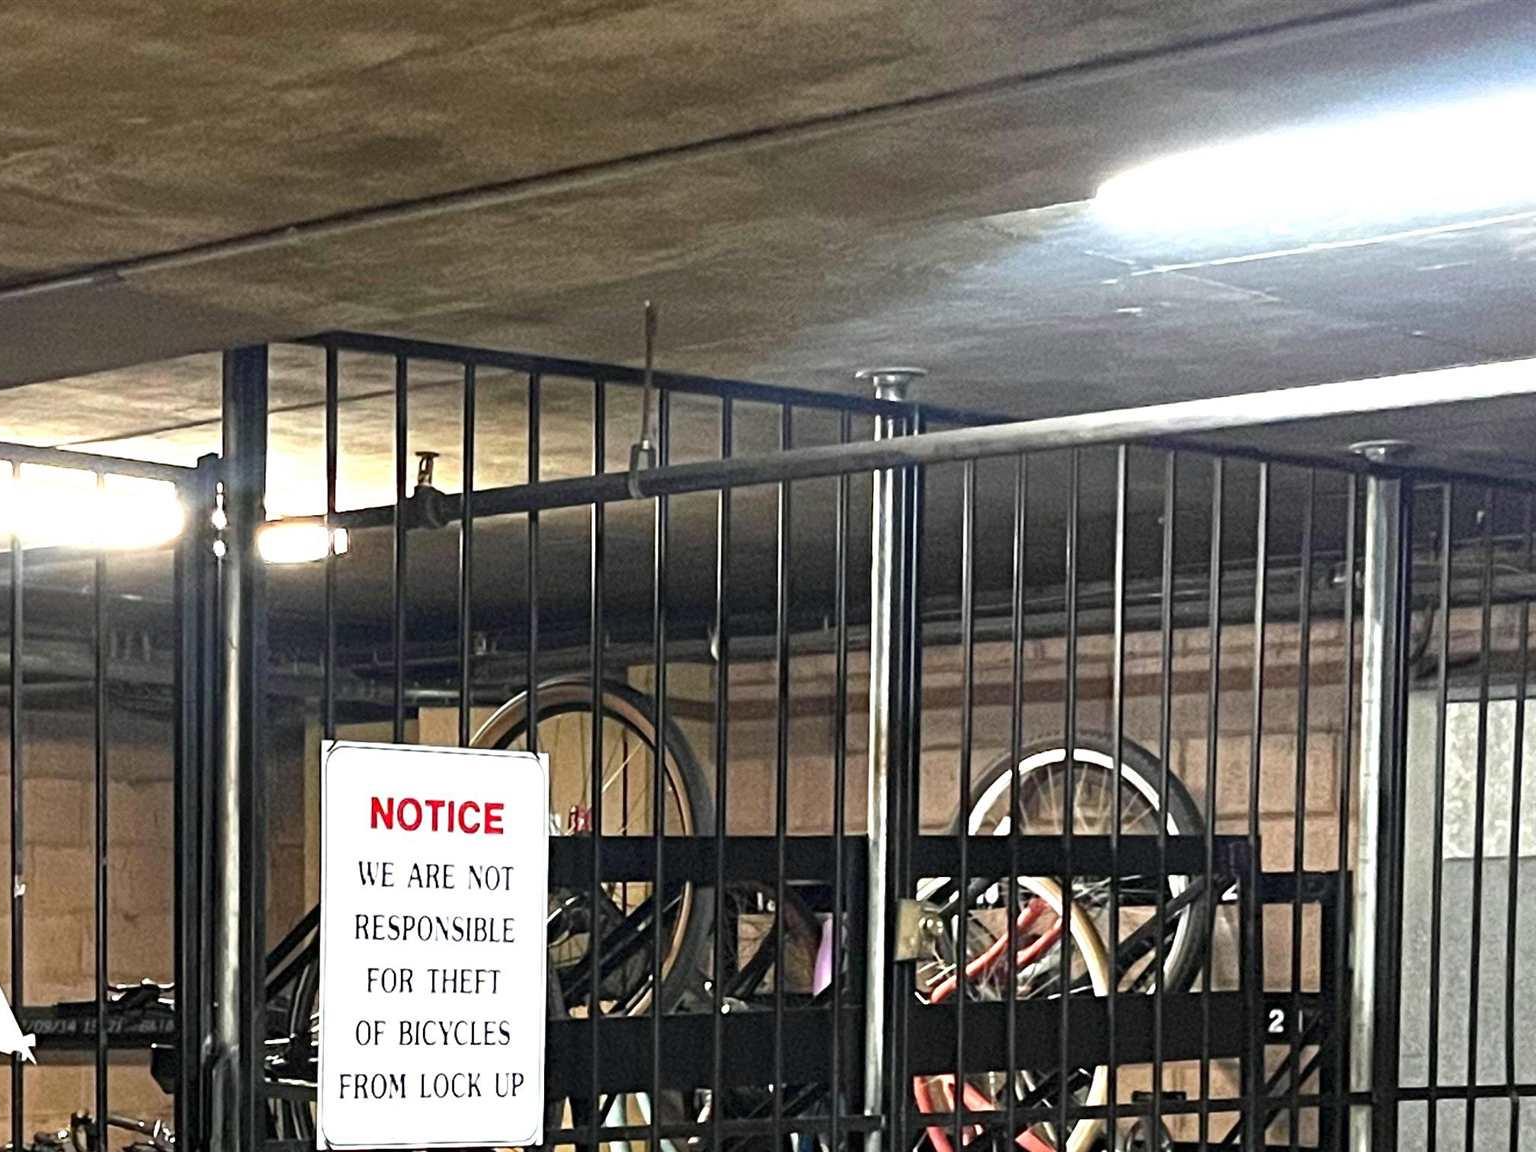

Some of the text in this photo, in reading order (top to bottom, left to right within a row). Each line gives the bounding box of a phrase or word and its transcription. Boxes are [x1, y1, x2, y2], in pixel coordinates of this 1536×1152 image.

[370, 797, 505, 835] NOTICE
[359, 861, 514, 891] WE ARE NOT
[355, 914, 515, 943] RESPONSIBLE
[368, 968, 501, 994] FOR THEFT
[355, 1020, 511, 1046] OF BICYCLES
[339, 1073, 525, 1100] FROM LOCK UP
